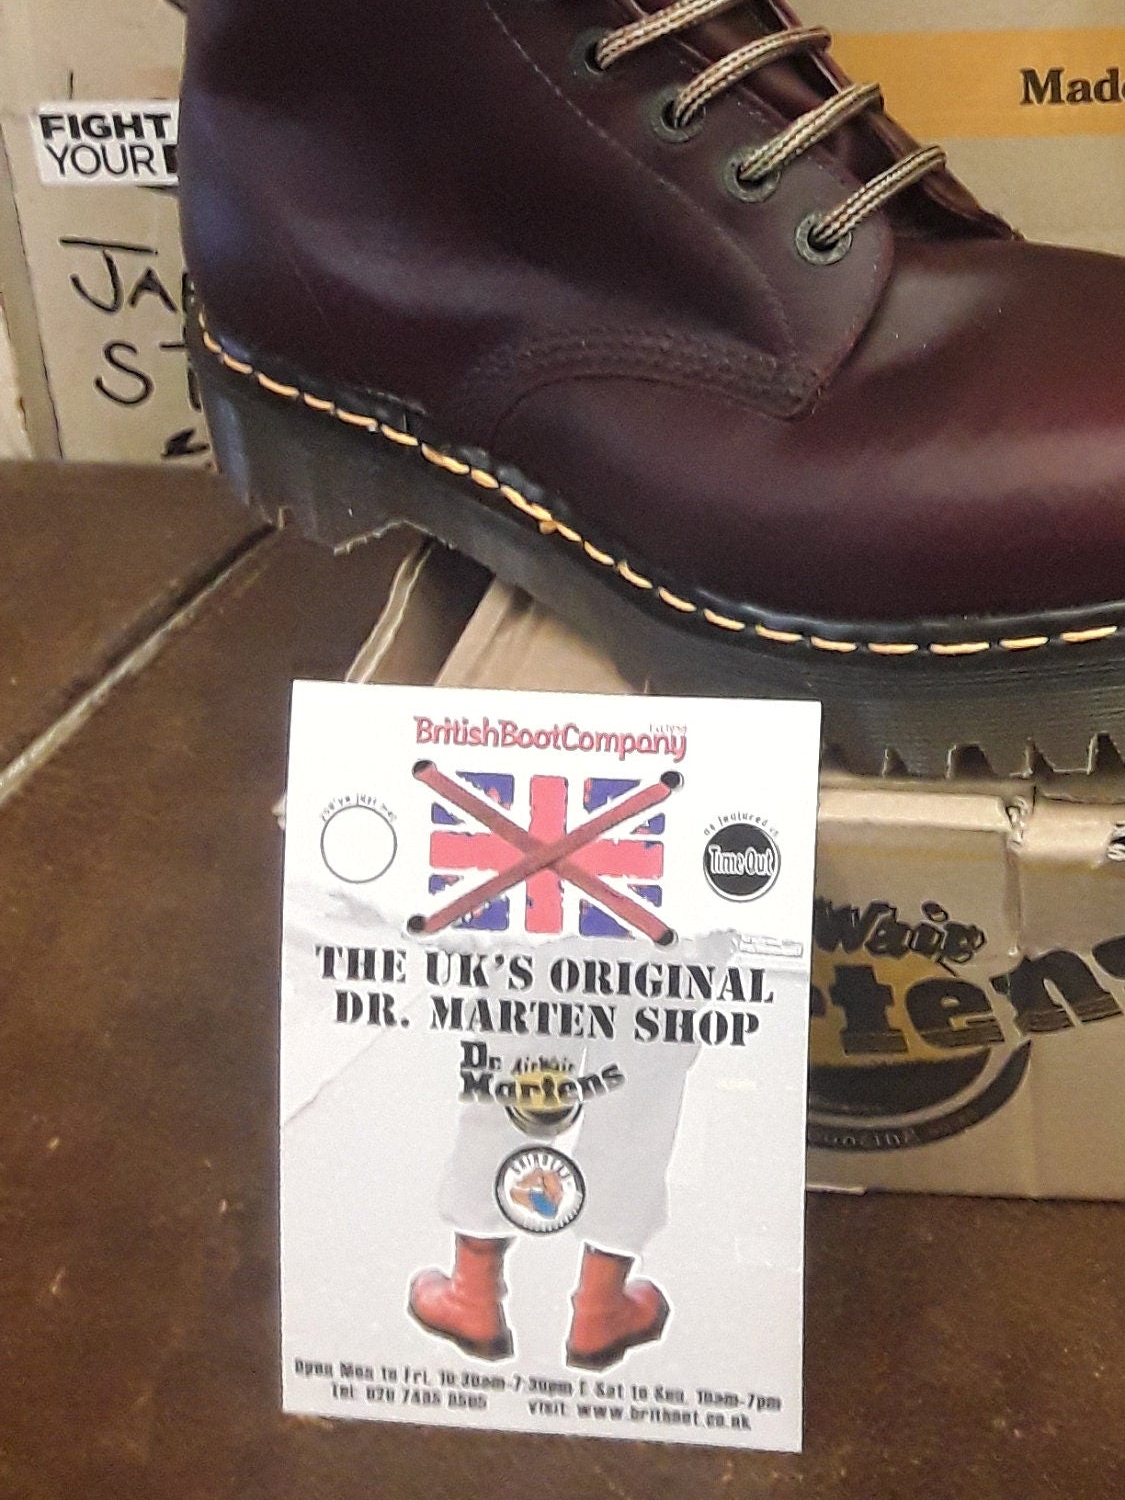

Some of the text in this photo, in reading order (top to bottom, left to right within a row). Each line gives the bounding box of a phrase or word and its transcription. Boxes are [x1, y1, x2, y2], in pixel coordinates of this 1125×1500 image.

[40, 113, 172, 141] FIGHT
[44, 143, 158, 177] YOUR
[413, 715, 688, 762] BritishBootCompany
[315, 944, 775, 1004] THE UK'S ORIGINAL
[334, 990, 760, 1047] DR. MARTEN SHOP
[458, 1062, 627, 1103] Martens
